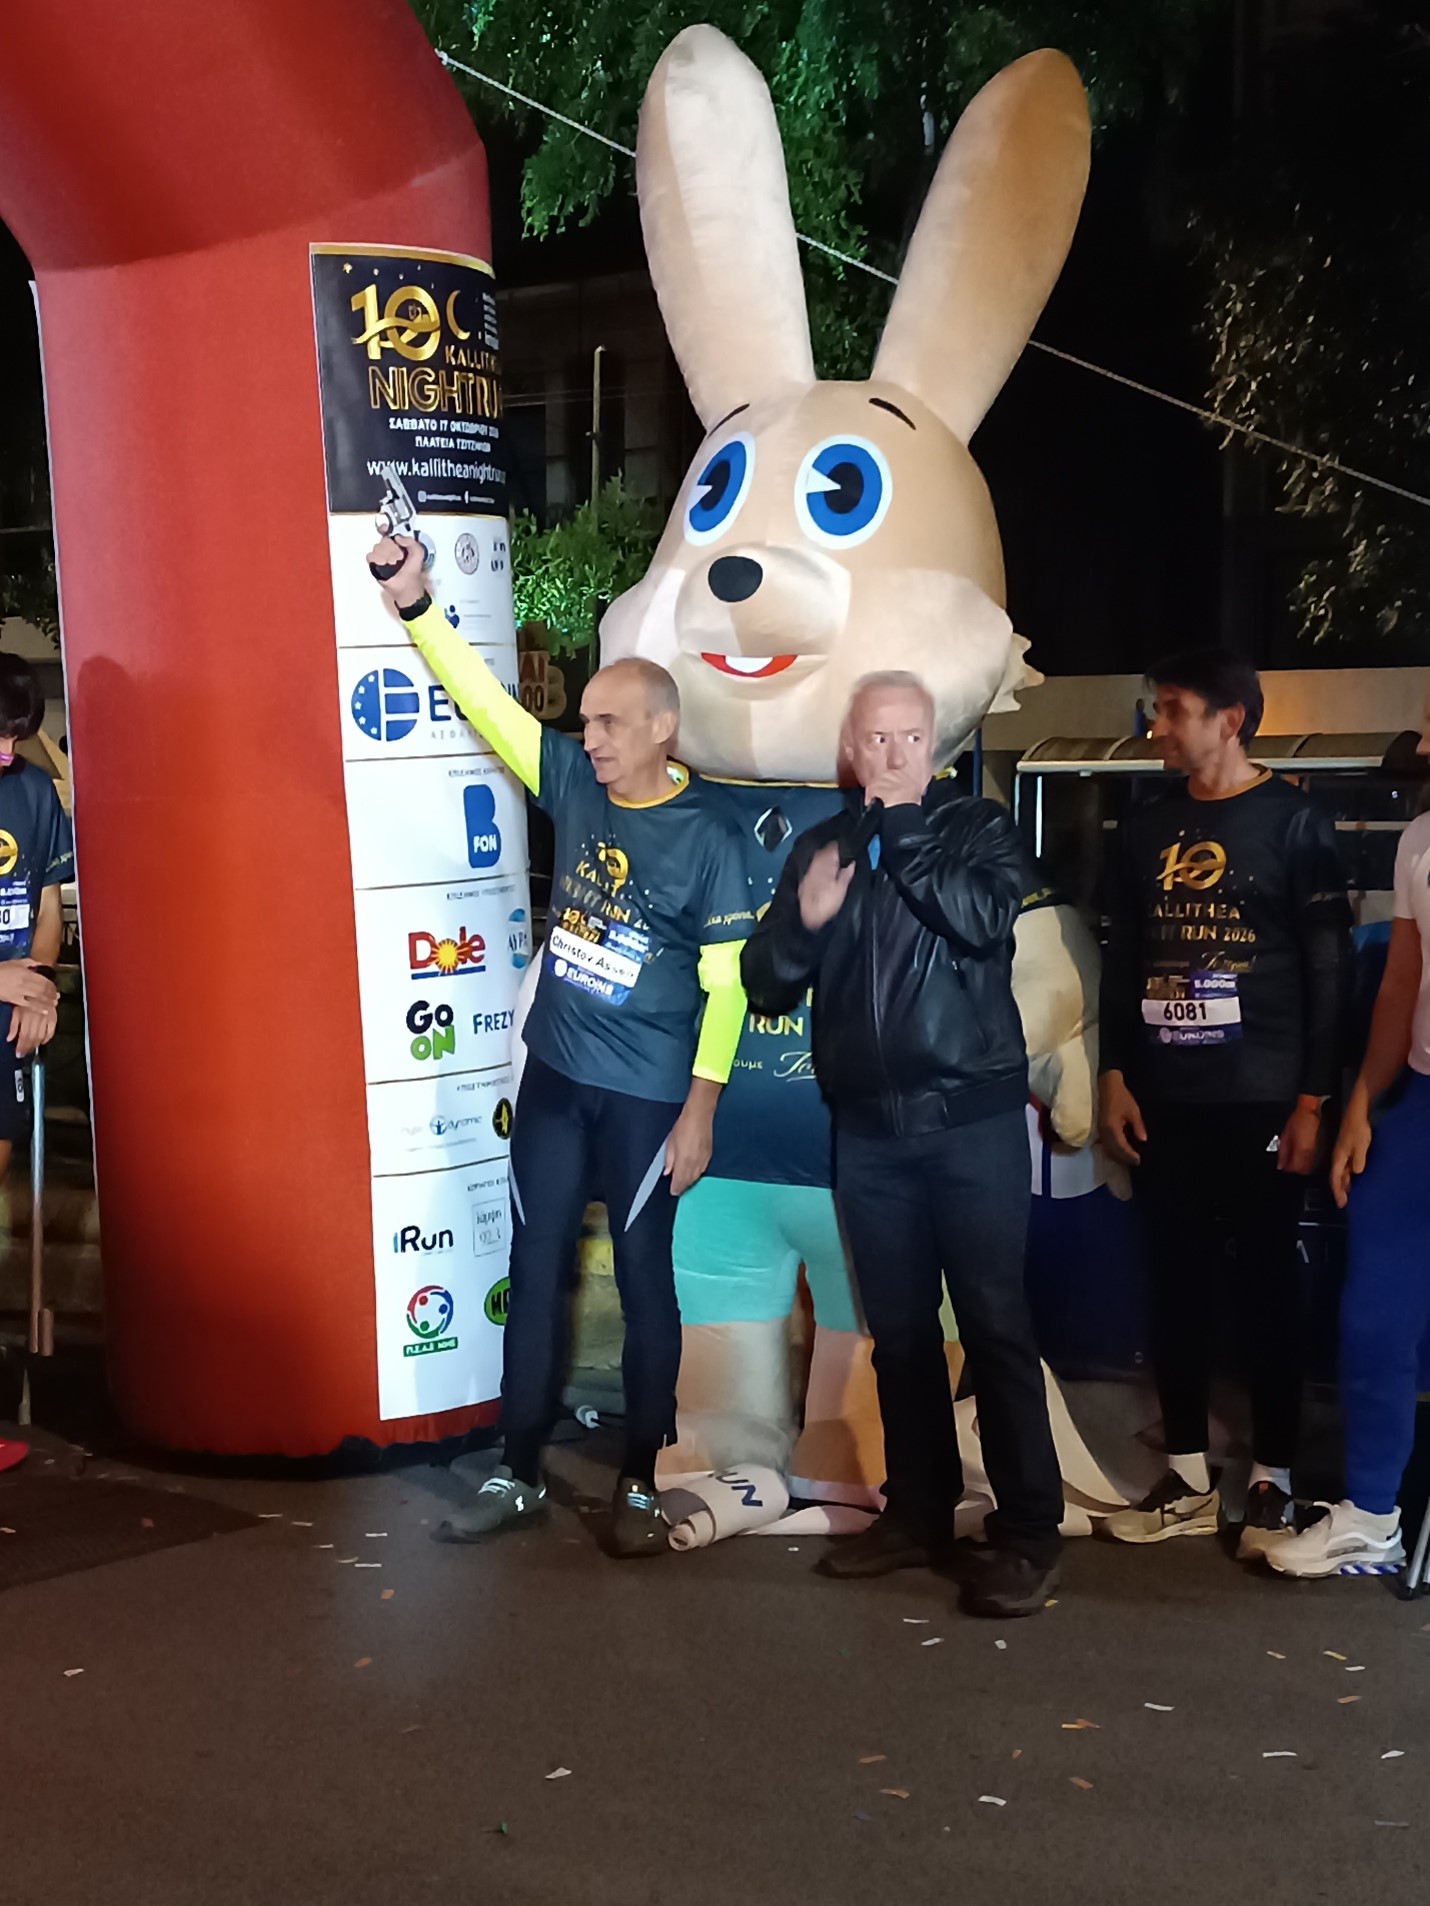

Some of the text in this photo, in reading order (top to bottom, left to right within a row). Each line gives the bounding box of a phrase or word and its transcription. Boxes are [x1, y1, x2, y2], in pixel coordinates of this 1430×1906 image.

[1152, 902, 1241, 920] ALLITHEA
[408, 926, 486, 971] Dole
[406, 1000, 454, 1034] GO
[1163, 1001, 1207, 1021] 6081
[410, 1024, 455, 1060] ON
